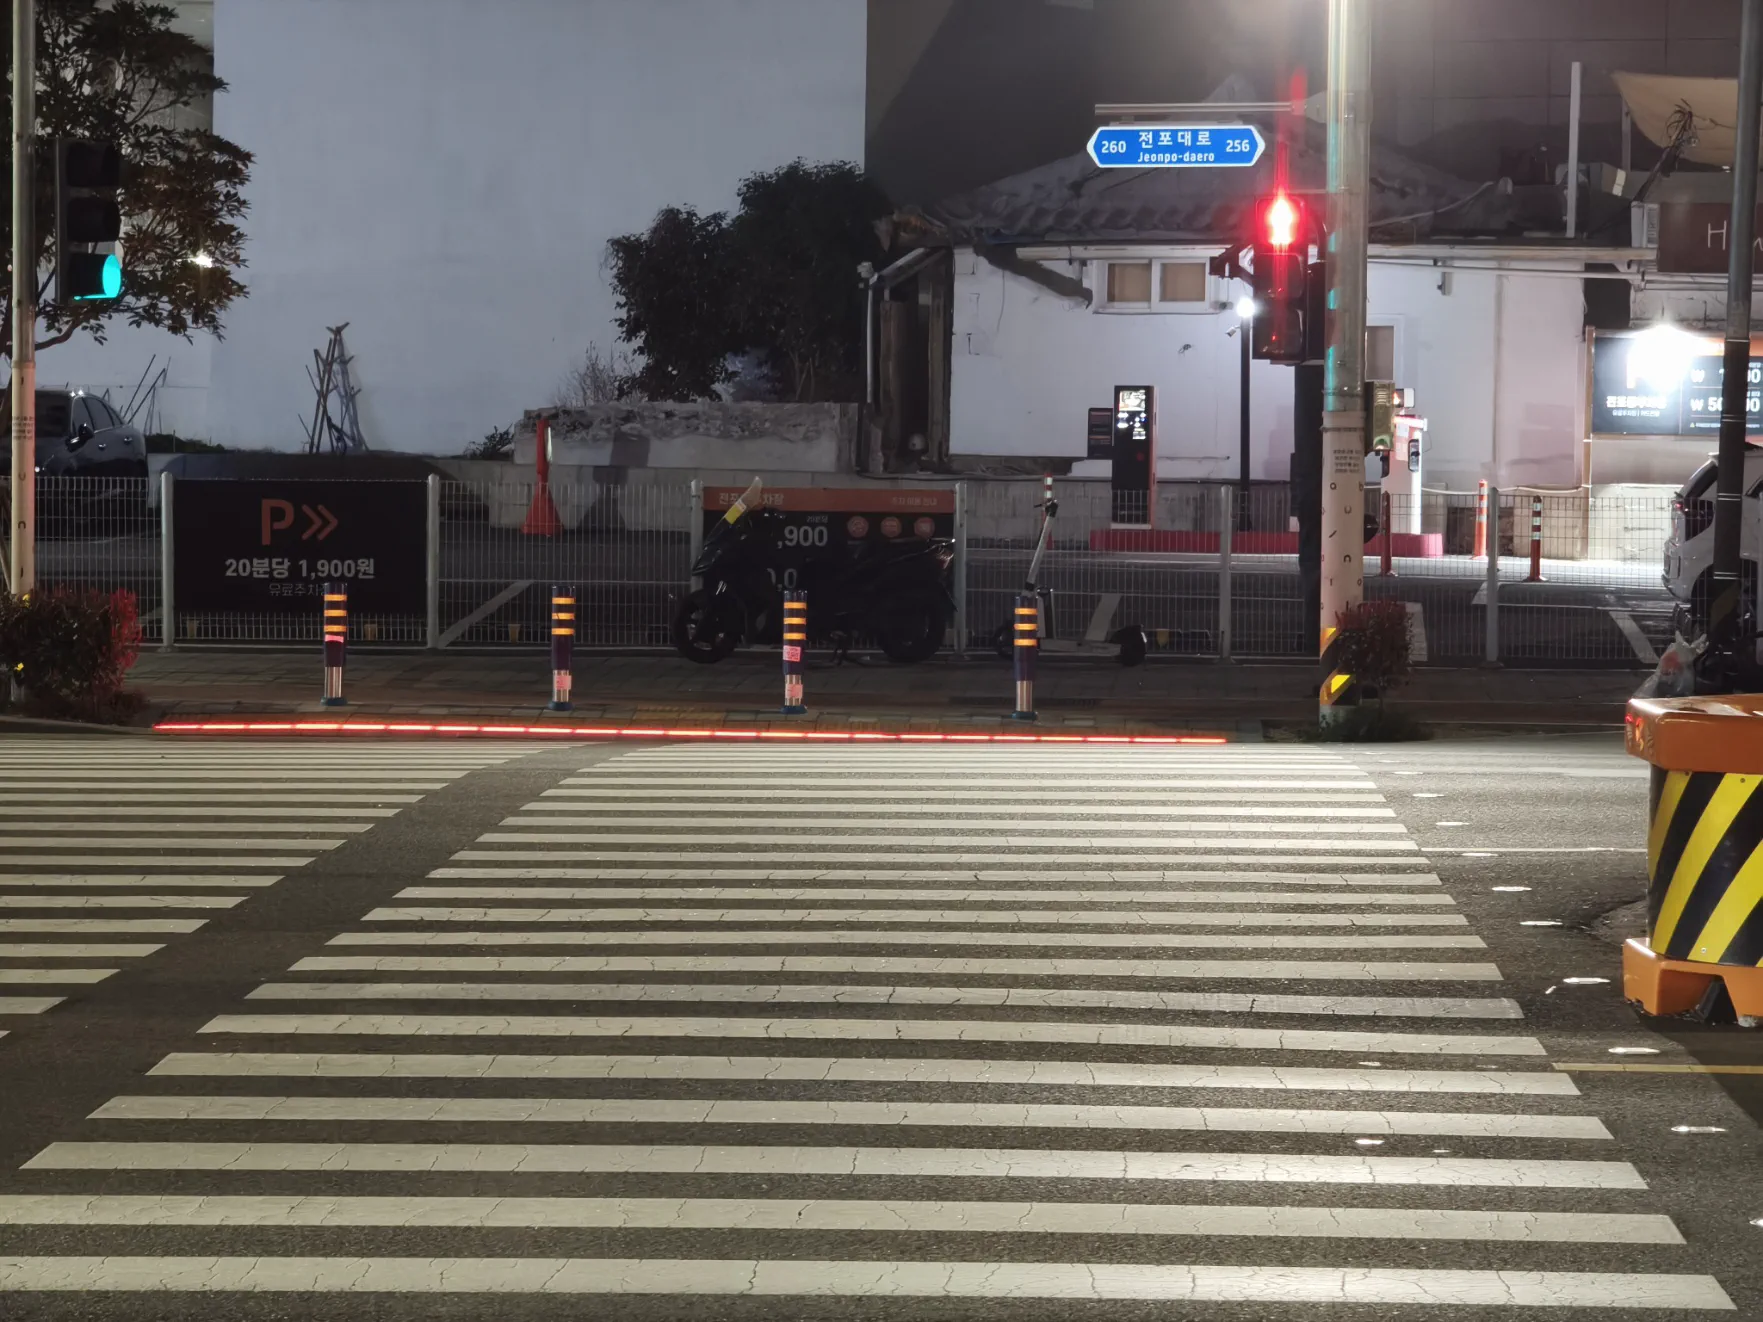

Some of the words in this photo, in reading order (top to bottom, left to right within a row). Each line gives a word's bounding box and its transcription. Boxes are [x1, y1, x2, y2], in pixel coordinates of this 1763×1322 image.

[1101, 140, 1127, 153] 260
[1138, 131, 1212, 149] 전포대로
[1225, 139, 1250, 152] 256
[1137, 151, 1215, 164] Jeonpo-daero
[261, 498, 294, 546] P
[776, 525, 828, 550] ,900
[225, 557, 291, 579] 20분당
[298, 557, 375, 580] 1,900원
